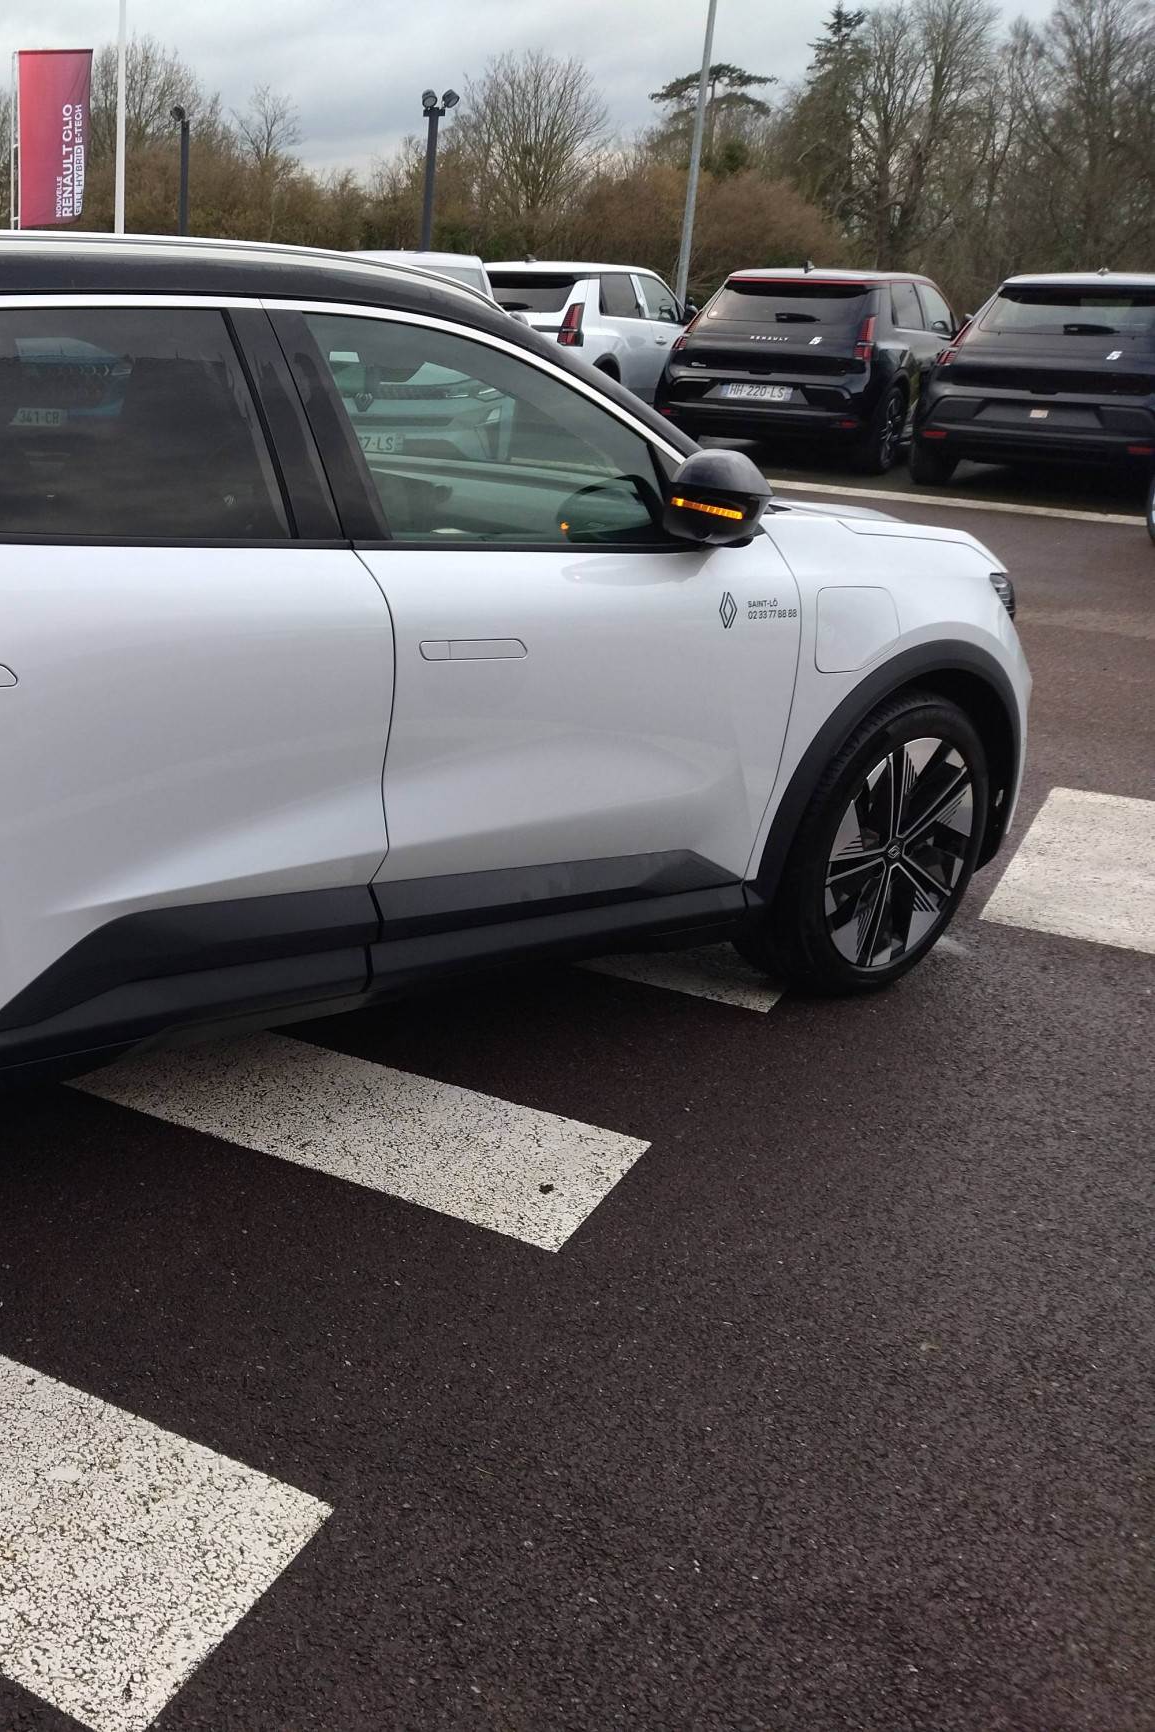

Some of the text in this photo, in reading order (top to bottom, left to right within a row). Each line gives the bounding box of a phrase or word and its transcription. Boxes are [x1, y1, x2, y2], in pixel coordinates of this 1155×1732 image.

[74, 104, 83, 144] E-TECH
[62, 104, 73, 217] RENAULT CLIO
[75, 146, 83, 187] HYBRID
[729, 383, 785, 398] HH-220-LS
[747, 608, 798, 620] 02 33 77 88 88
